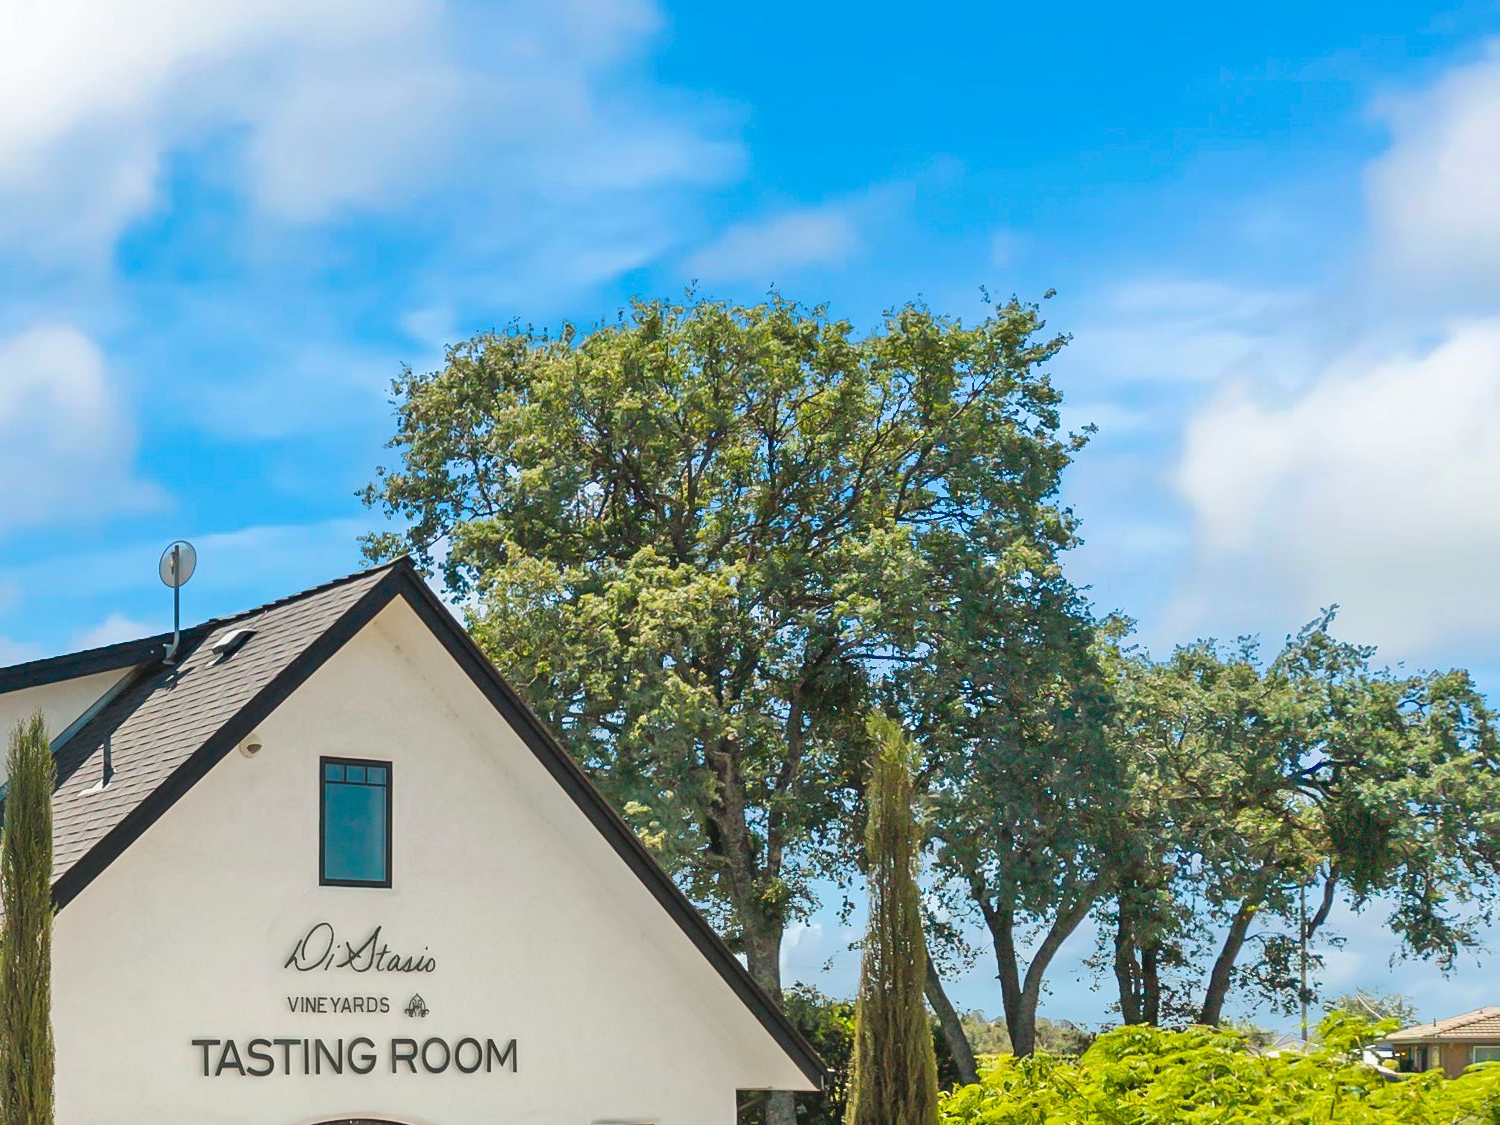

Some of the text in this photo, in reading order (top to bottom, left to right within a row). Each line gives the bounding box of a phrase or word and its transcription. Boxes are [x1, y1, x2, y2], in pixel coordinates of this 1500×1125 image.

[287, 996, 391, 1014] VINEYARDS
[191, 1036, 519, 1077] TASTING ROOM
